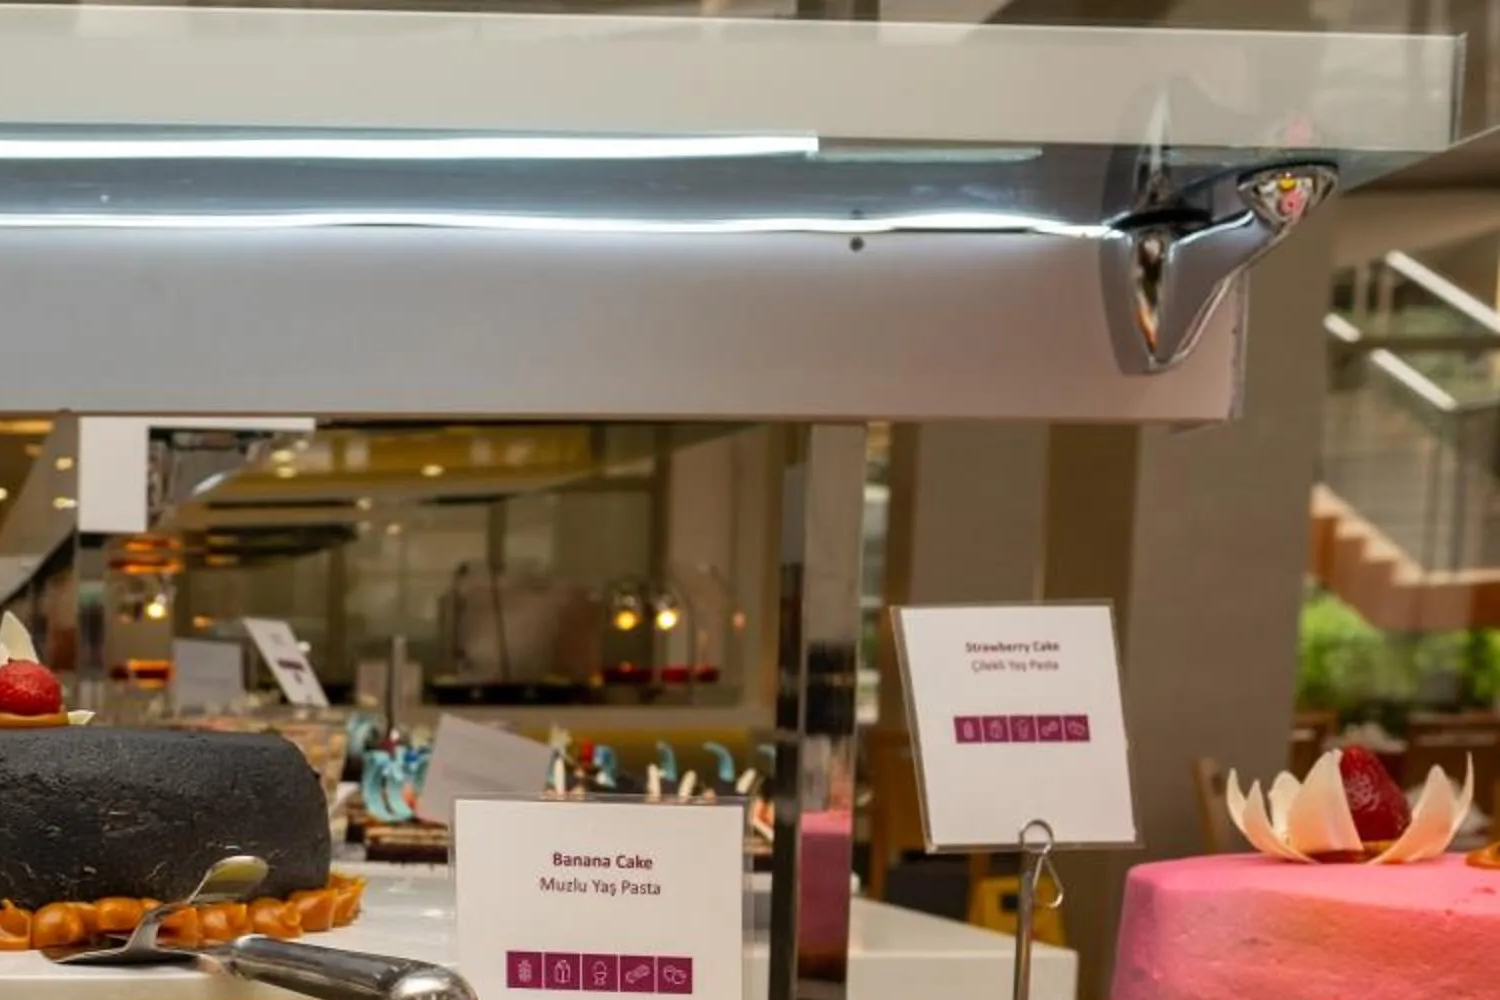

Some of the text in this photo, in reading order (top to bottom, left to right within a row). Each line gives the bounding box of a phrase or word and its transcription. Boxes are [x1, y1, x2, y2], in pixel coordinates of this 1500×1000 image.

[965, 640, 1060, 654] Strawberry Cake
[1029, 659, 1059, 671] Pasta
[552, 851, 653, 869] Banana Cake
[540, 877, 661, 897] Muzlu Yaş Pasta
